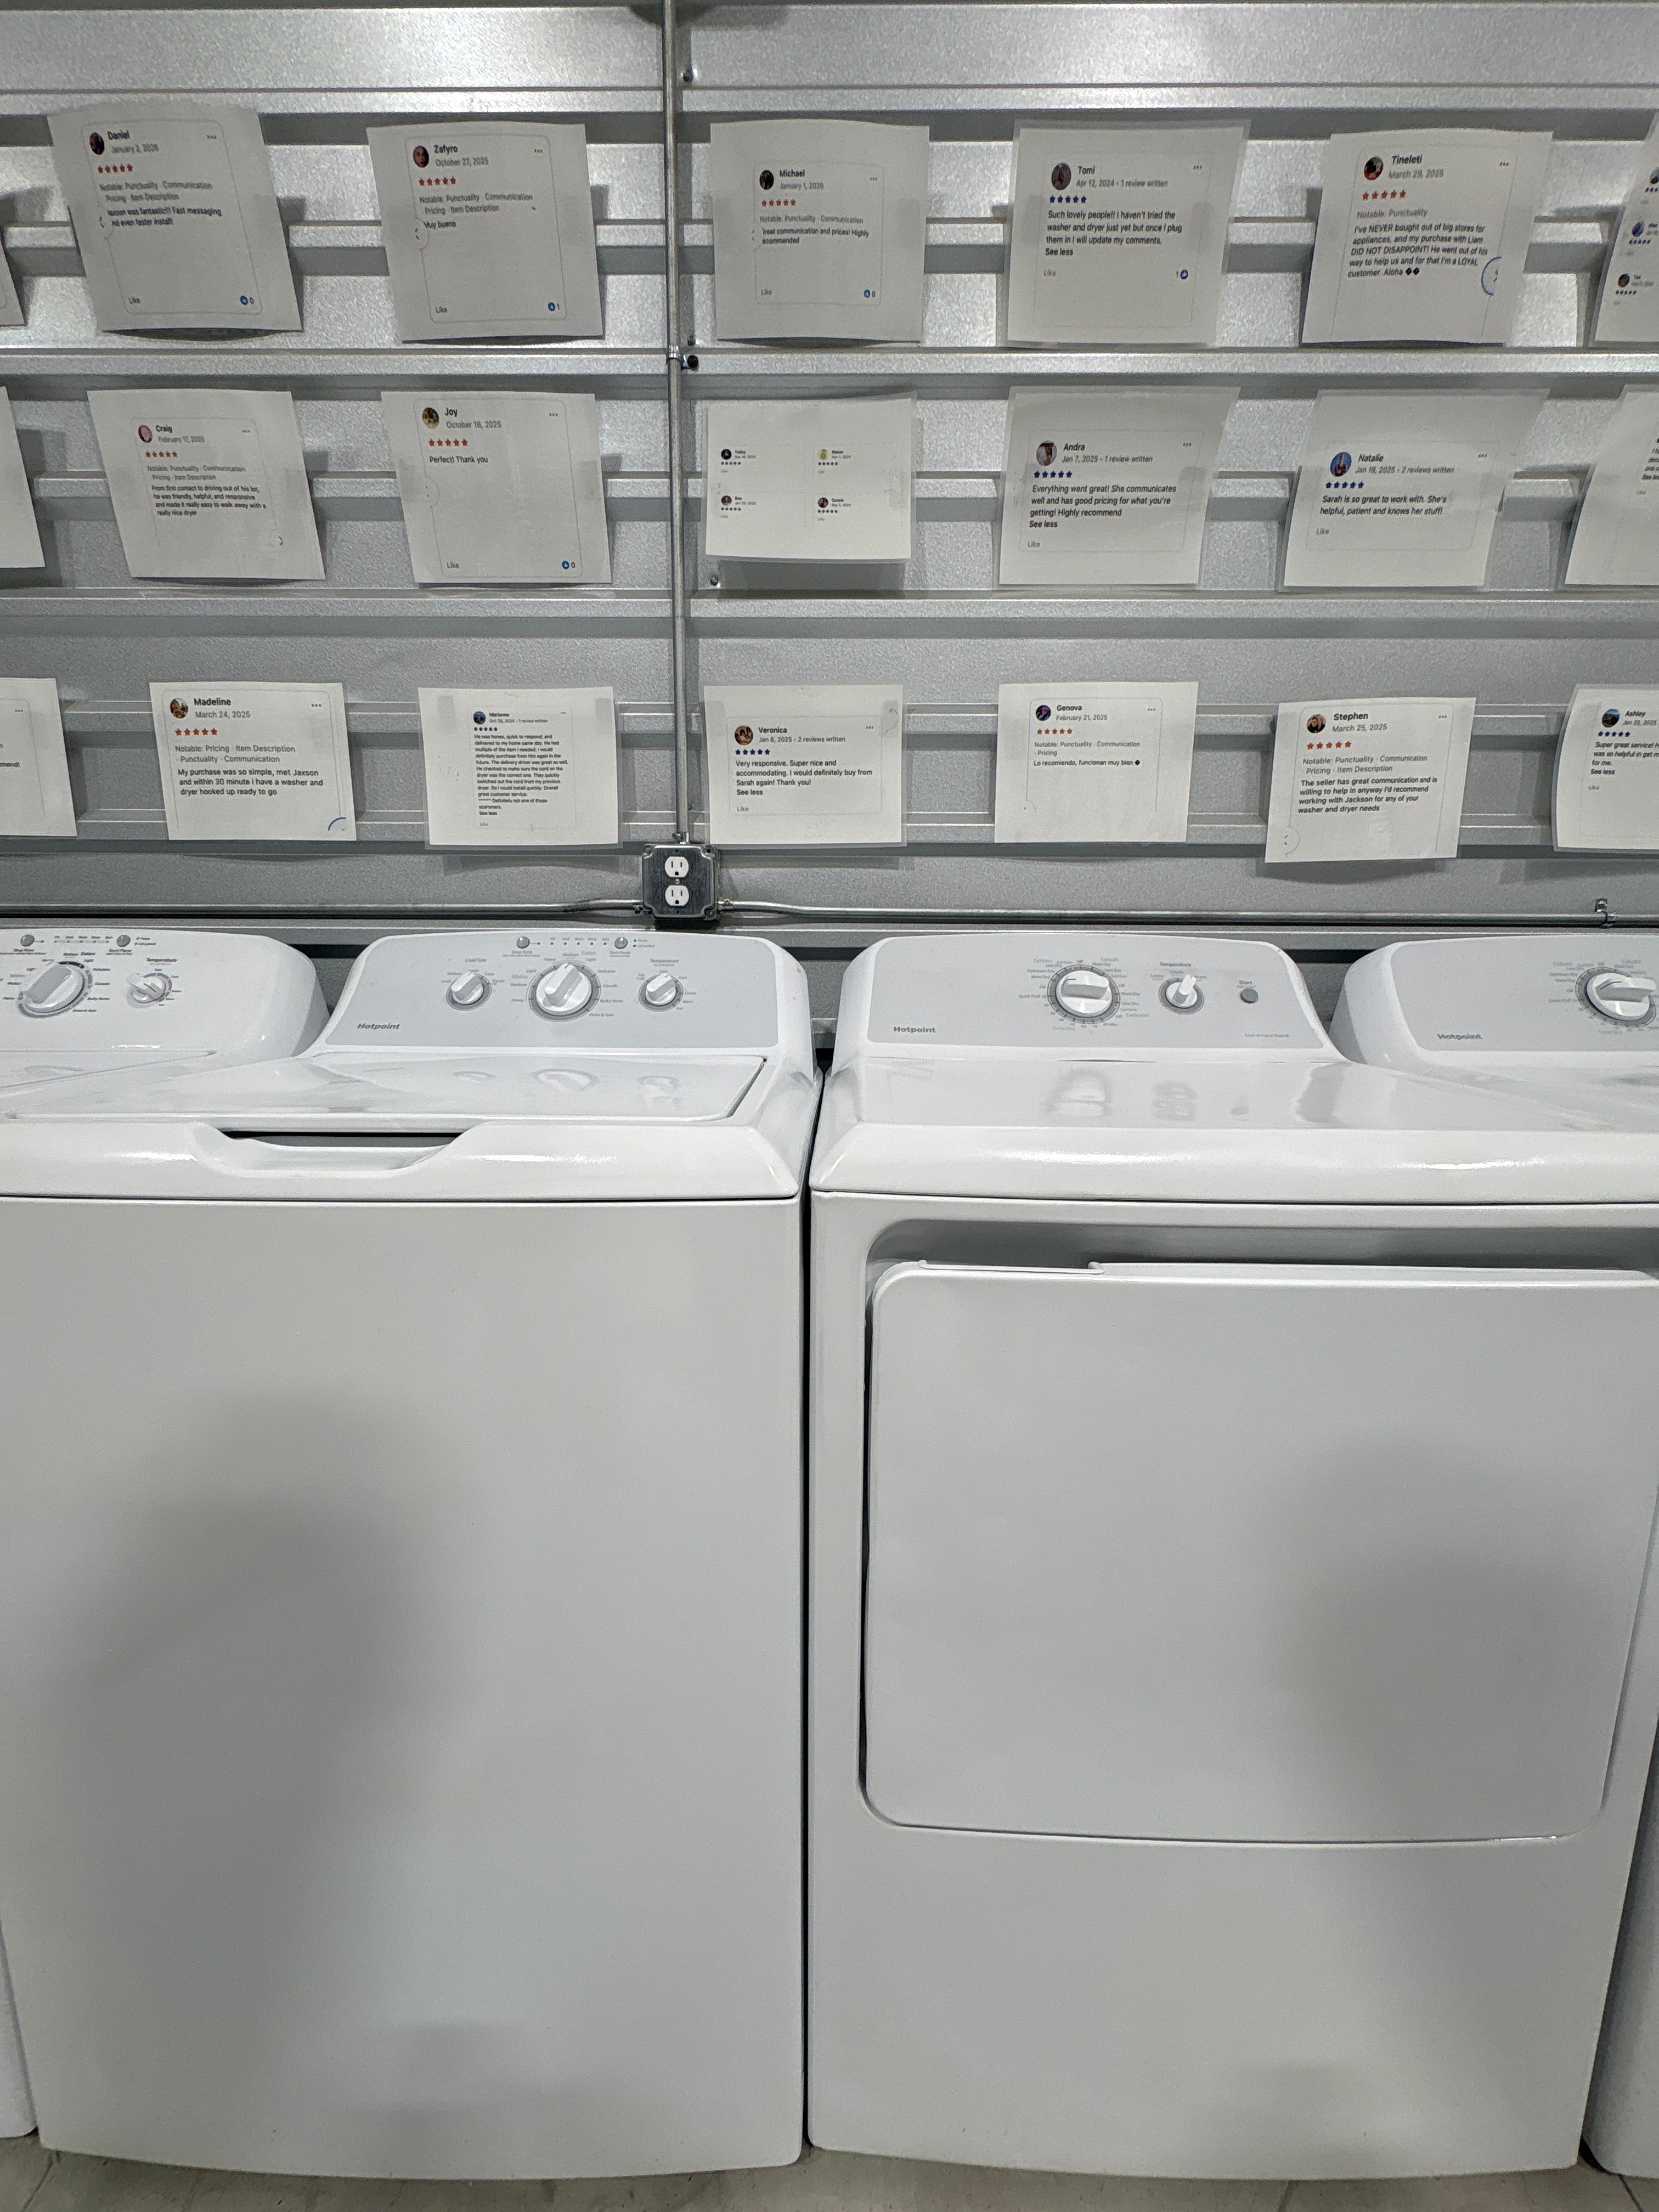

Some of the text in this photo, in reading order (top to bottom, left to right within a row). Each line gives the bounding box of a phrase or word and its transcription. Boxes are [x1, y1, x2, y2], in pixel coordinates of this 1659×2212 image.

[434, 145, 458, 154] Zafyro
[1389, 170, 1410, 179] March
[1048, 210, 1065, 218] Such
[1066, 210, 1086, 220] lovely
[1121, 211, 1146, 219] haven't
[1148, 211, 1163, 219] tried
[1165, 211, 1175, 219] the
[1369, 223, 1393, 233] NEVER
[1395, 223, 1419, 233] bought
[1443, 223, 1453, 233] big
[445, 408, 458, 417] Joy
[485, 420, 501, 428] 2025
[1064, 443, 1085, 451] Andra
[1032, 484, 1069, 494] Everything
[1089, 485, 1109, 494] great!
[1075, 496, 1093, 506] good
[1094, 496, 1118, 506] pricing
[1149, 496, 1171, 506] you're
[1362, 496, 1380, 504] great
[1030, 509, 1056, 518] getting!
[1058, 509, 1080, 517] Highly
[1320, 507, 1345, 516] helpful,
[1347, 507, 1371, 516] patient
[1334, 712, 1368, 721] Stephen
[180, 788, 198, 797] dryer
